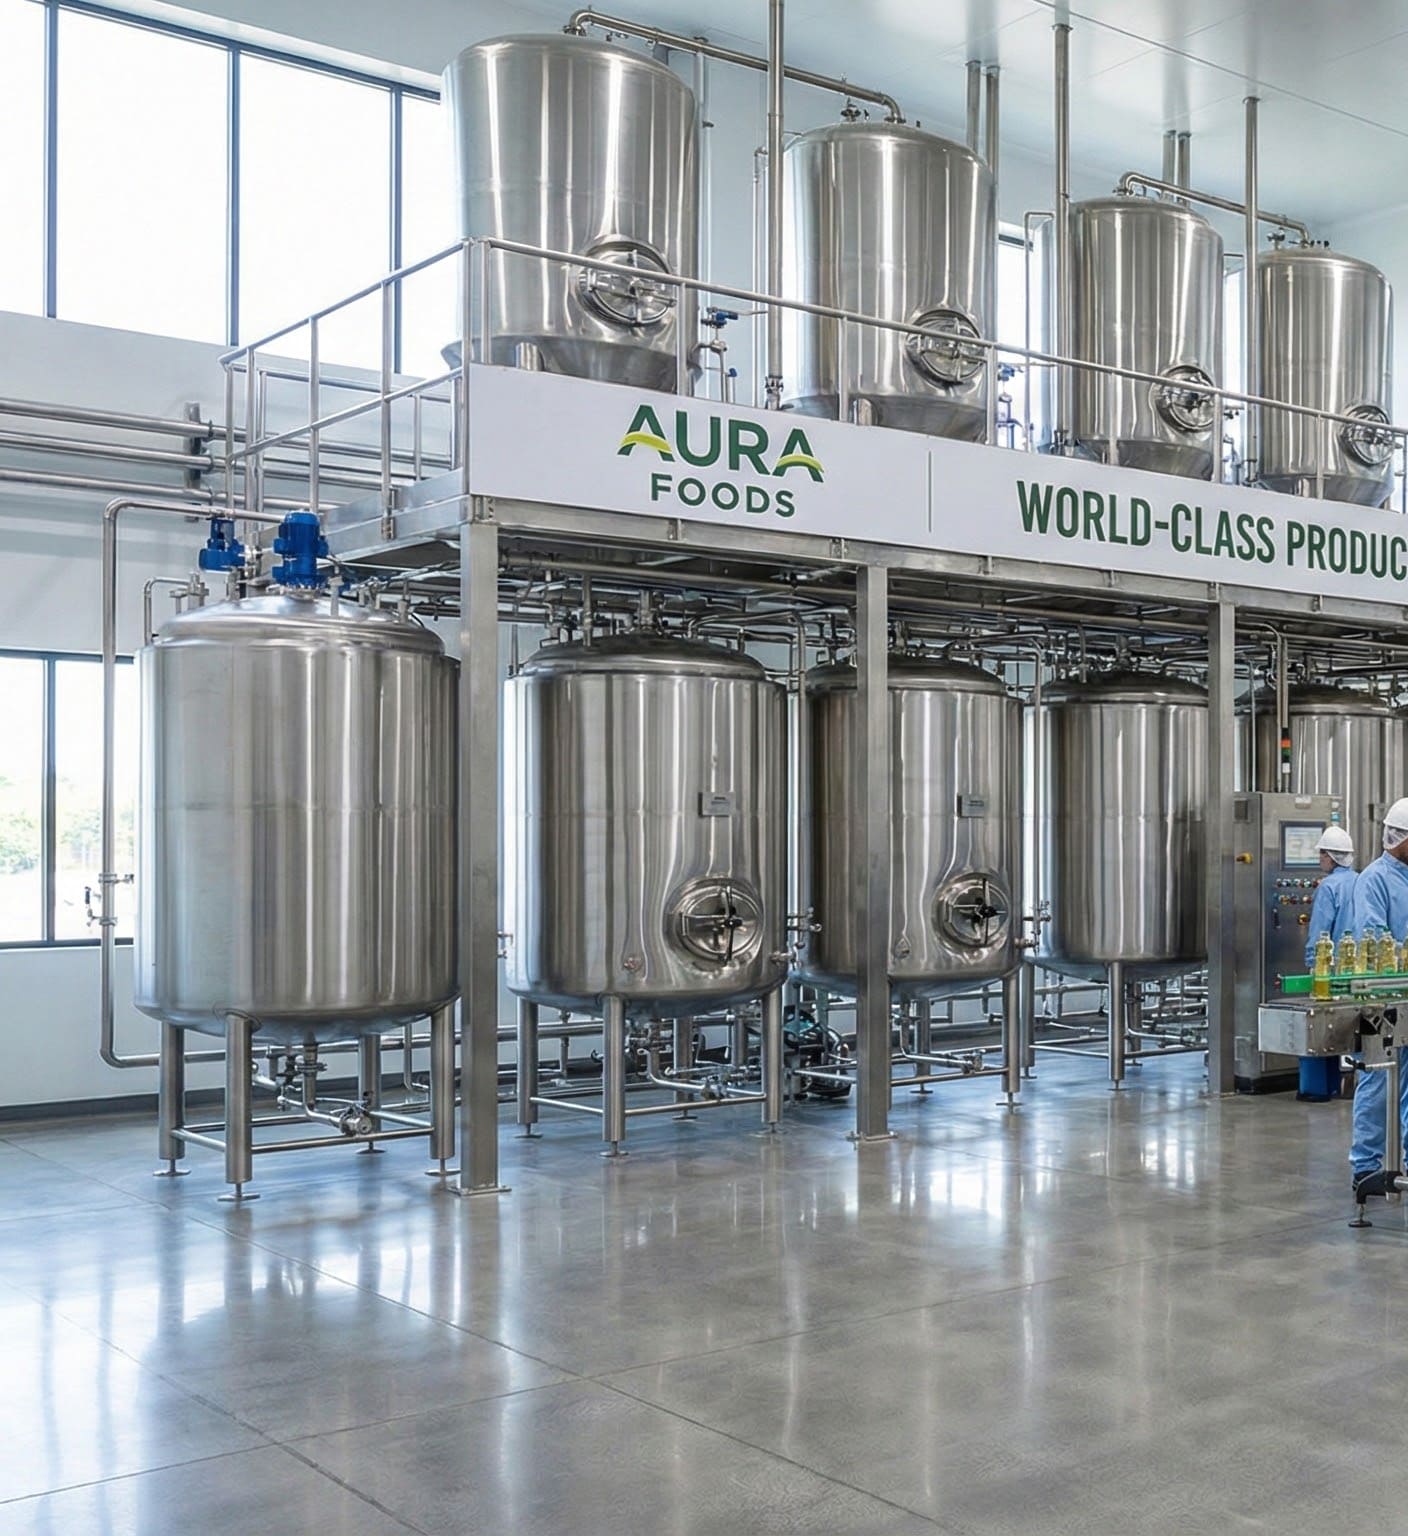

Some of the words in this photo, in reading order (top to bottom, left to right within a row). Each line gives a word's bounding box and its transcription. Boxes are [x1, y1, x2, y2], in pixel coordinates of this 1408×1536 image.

[617, 404, 825, 483] AURA
[651, 473, 795, 517] FOODS
[1016, 480, 1275, 563] WORLD-CLASS
